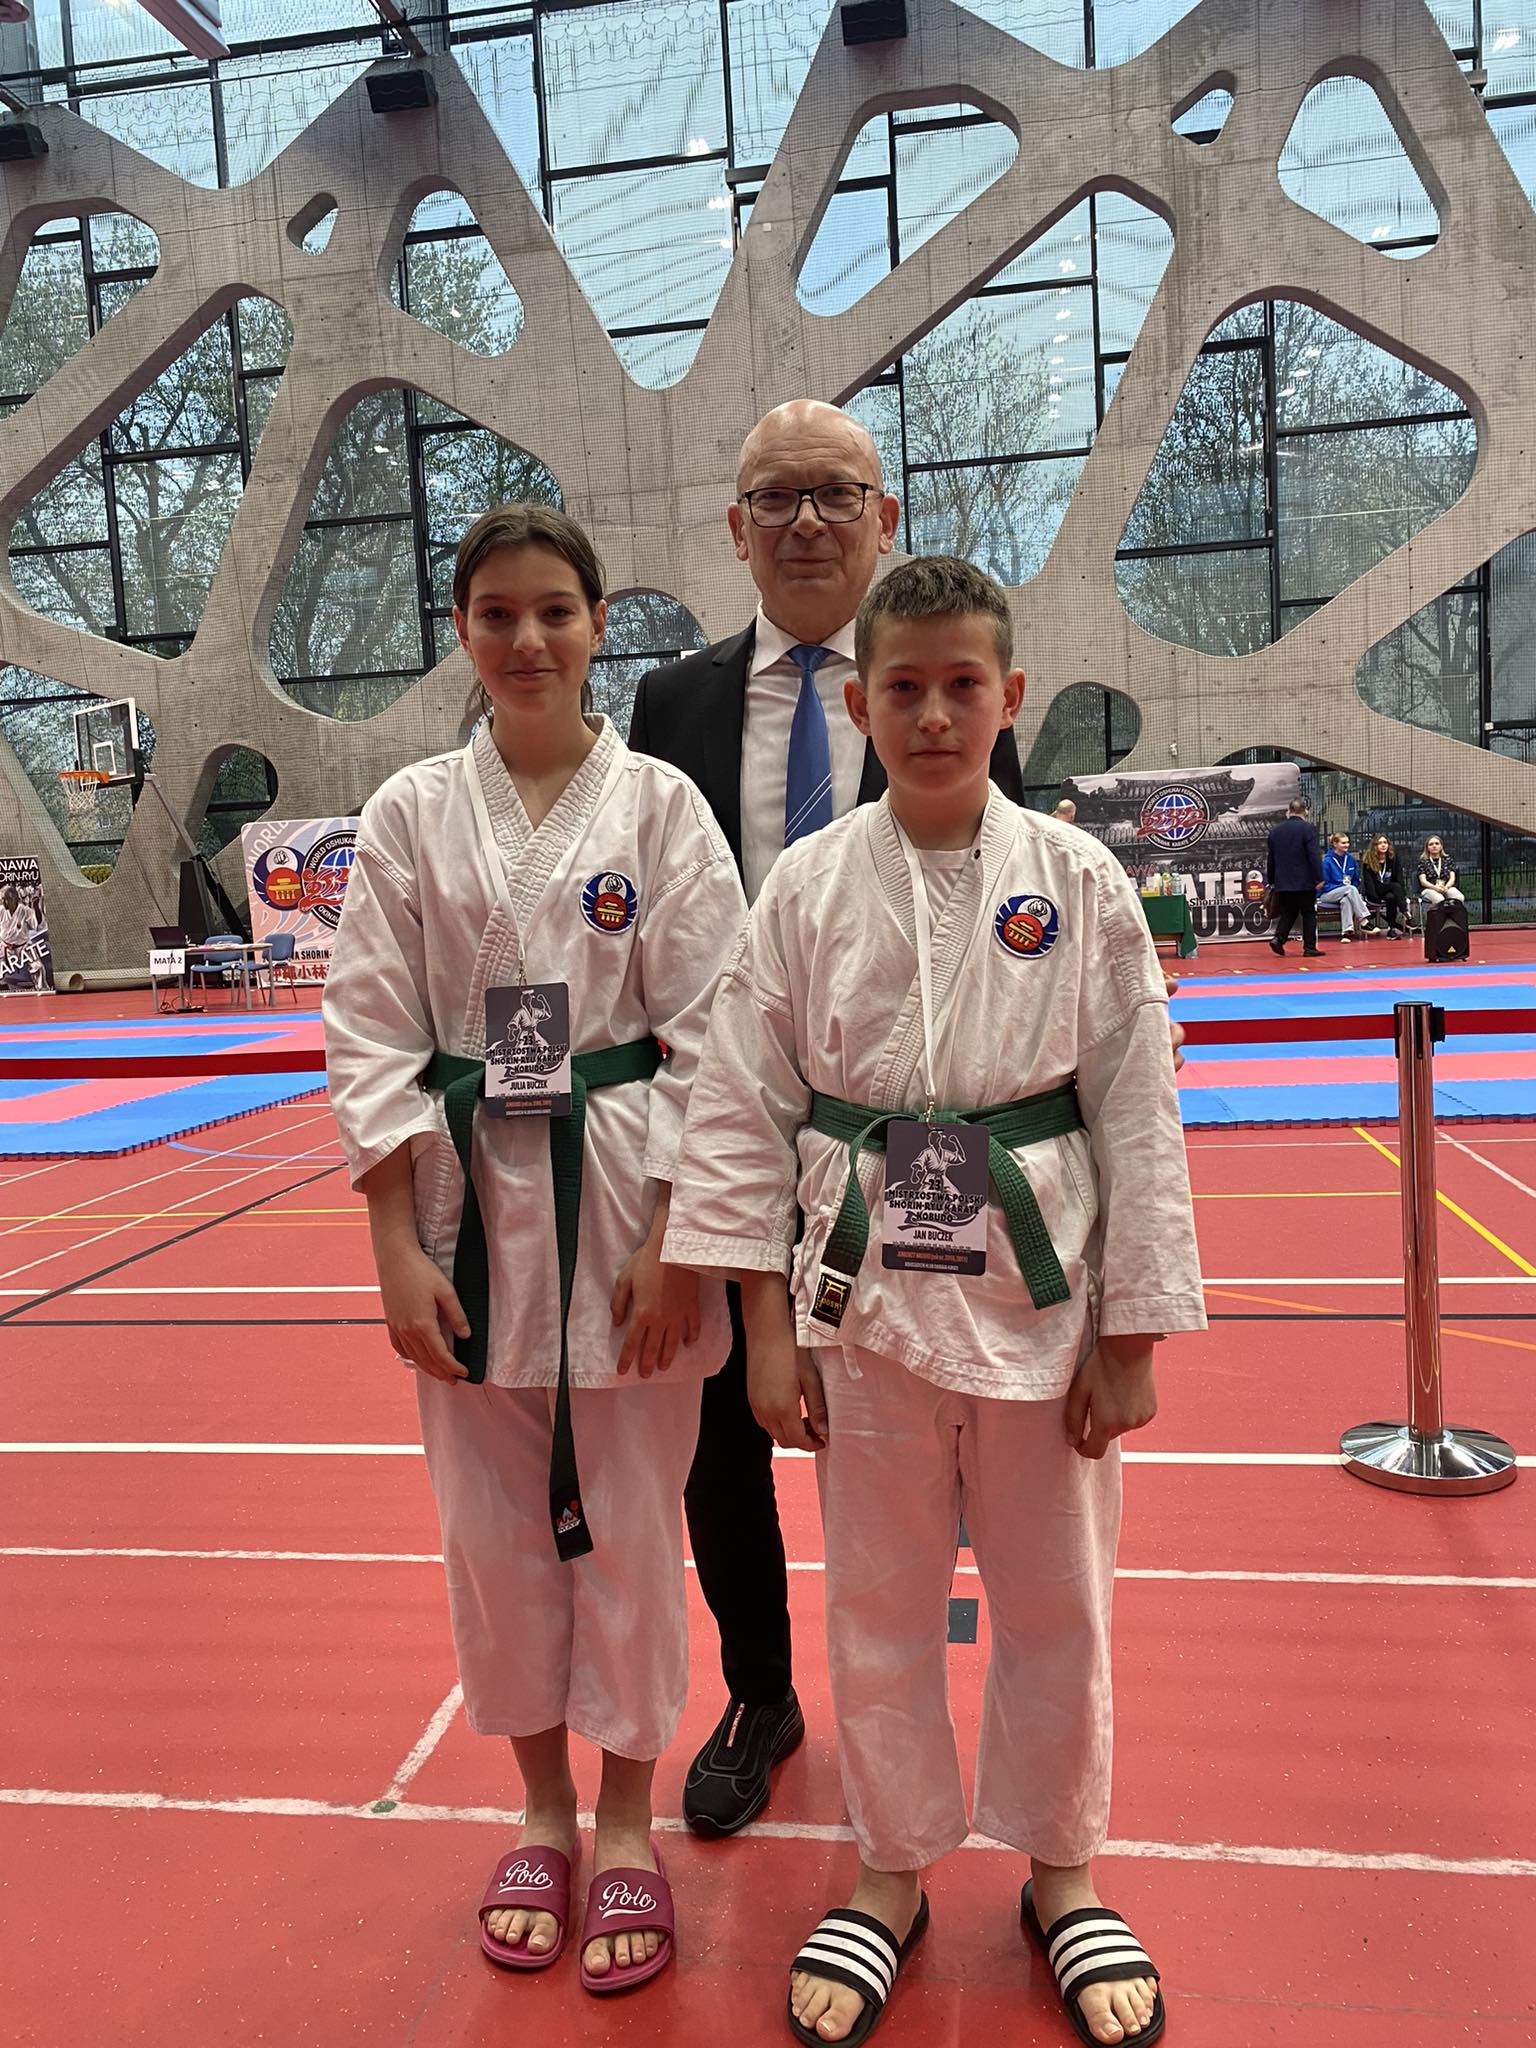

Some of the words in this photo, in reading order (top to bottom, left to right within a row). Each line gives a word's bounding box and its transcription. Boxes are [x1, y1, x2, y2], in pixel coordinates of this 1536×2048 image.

[308, 847, 327, 869] WORLD
[153, 956, 176, 966] MATA
[177, 956, 183, 965] 2
[523, 1035, 534, 1046] 23
[514, 1064, 545, 1073] KOBUDO
[510, 1081, 526, 1090] JULIA
[527, 1079, 548, 1090] BUCZEK
[928, 1179, 941, 1190] 23
[916, 1211, 953, 1222] KOBUDO
[913, 1229, 927, 1240] JAN
[928, 1230, 954, 1241] BUCZEK
[499, 1859, 553, 1891] Polo
[599, 1881, 657, 1915] Polo
